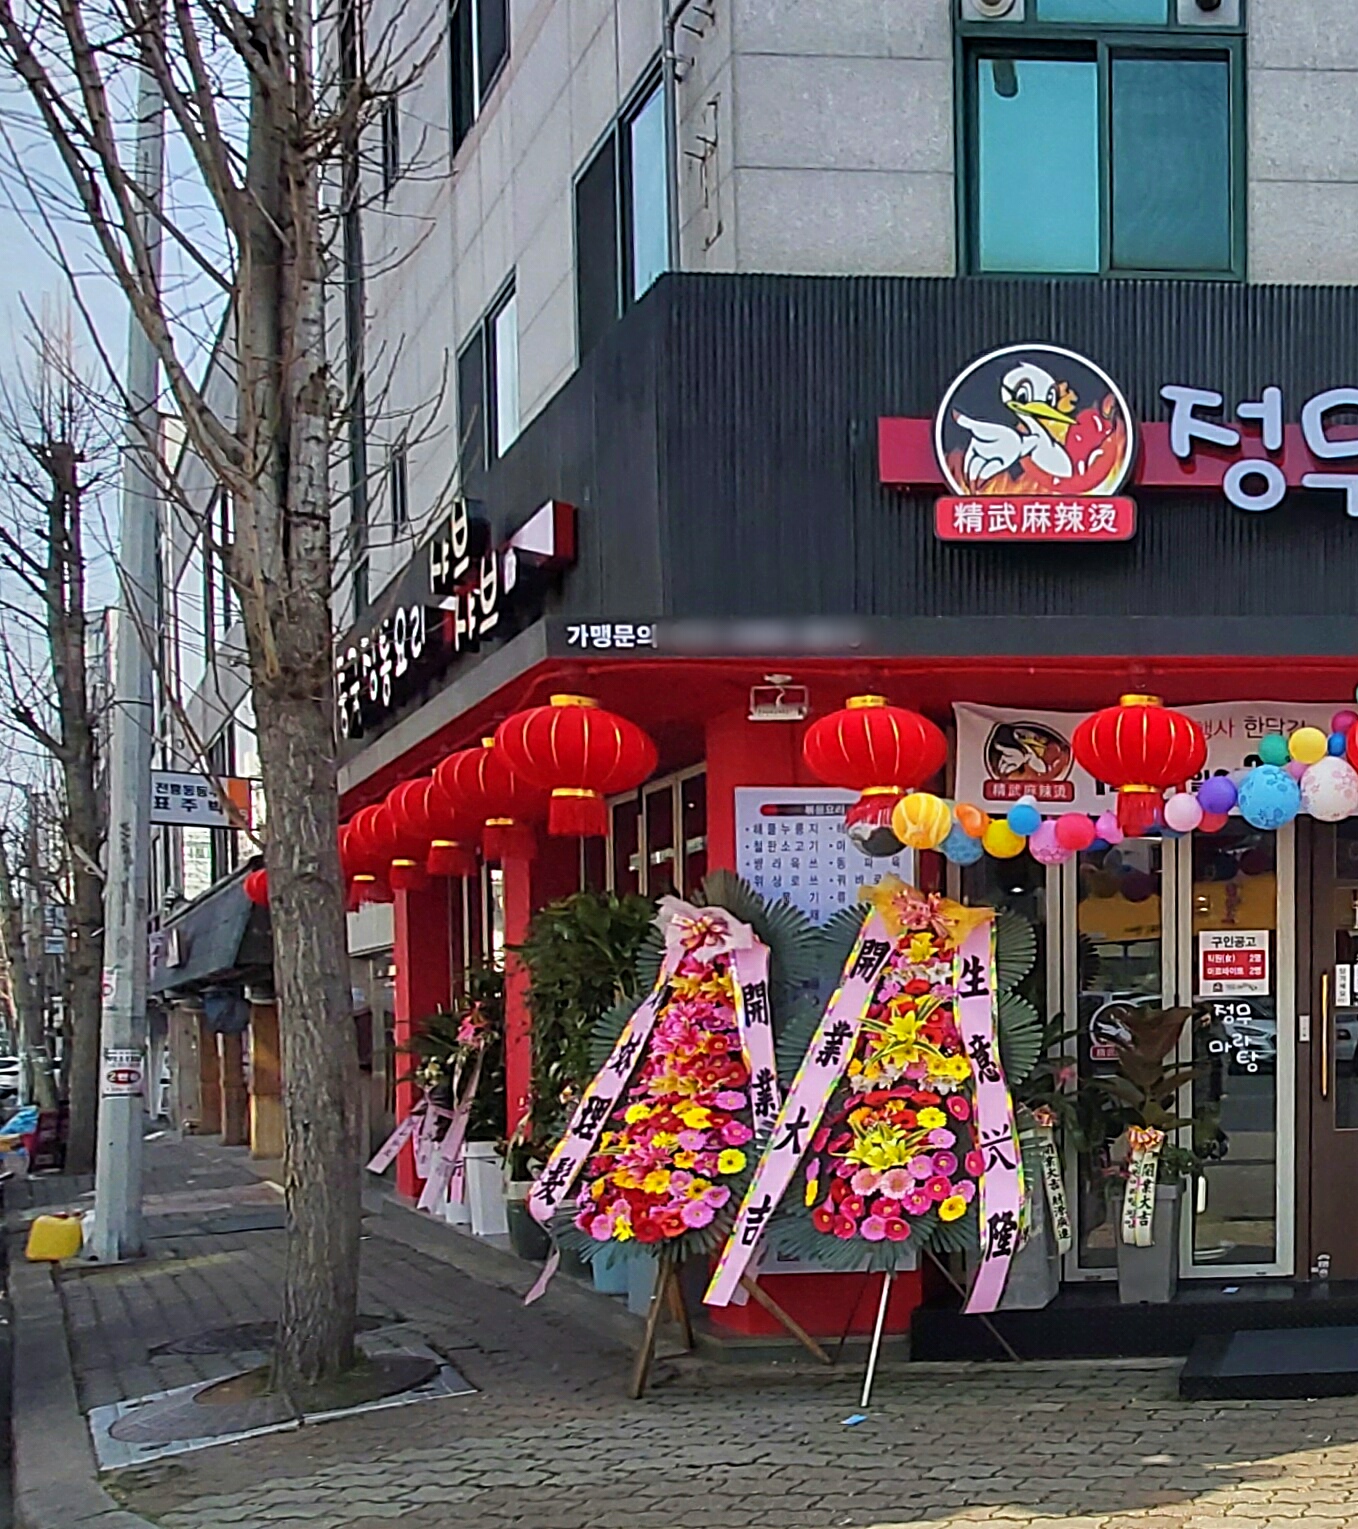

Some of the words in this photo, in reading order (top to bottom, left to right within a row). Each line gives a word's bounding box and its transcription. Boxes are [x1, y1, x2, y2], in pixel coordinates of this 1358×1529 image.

[953, 501, 1119, 536] 精武麻辣烫
[567, 623, 658, 649] 가맹문의
[1211, 936, 1257, 948] 구인공고
